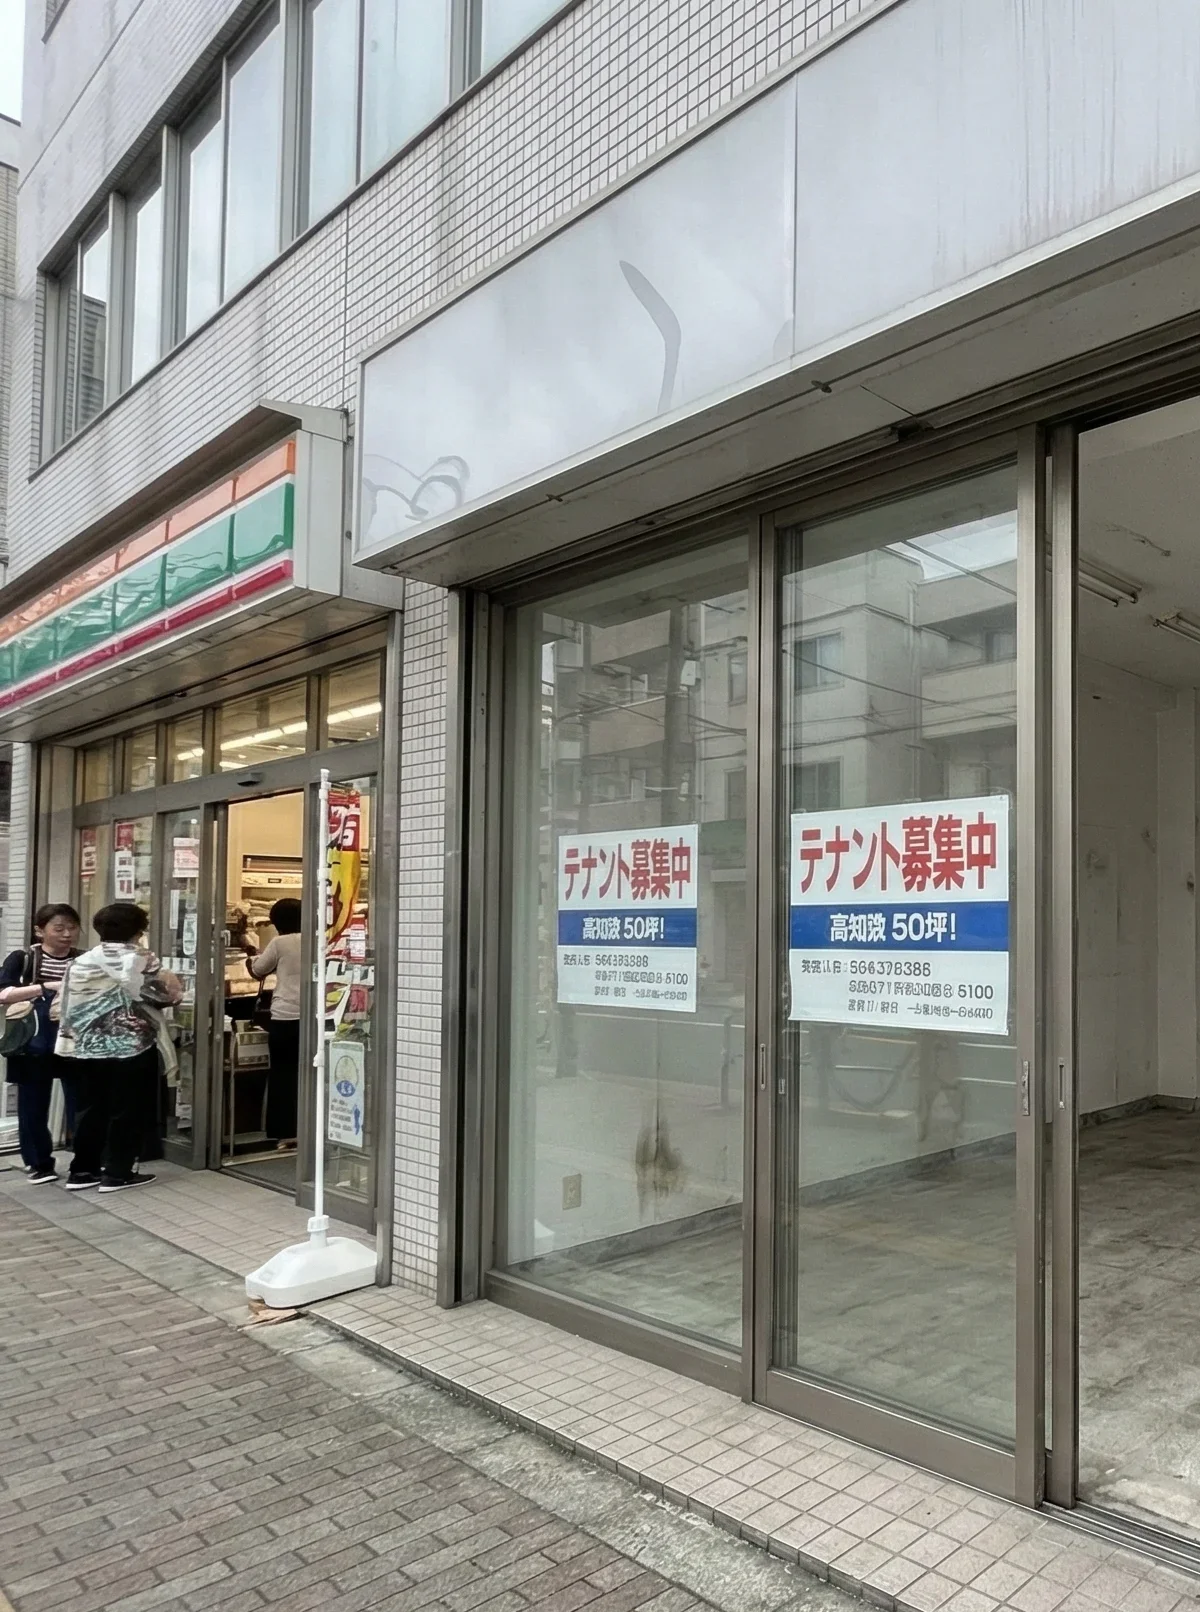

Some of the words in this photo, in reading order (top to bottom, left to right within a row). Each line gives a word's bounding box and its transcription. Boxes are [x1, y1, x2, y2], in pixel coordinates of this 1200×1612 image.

[564, 836, 691, 901] テナント募集中
[800, 811, 997, 894] テナント募集中
[891, 911, 956, 943] 50坪!
[957, 984, 994, 1000] 5100
